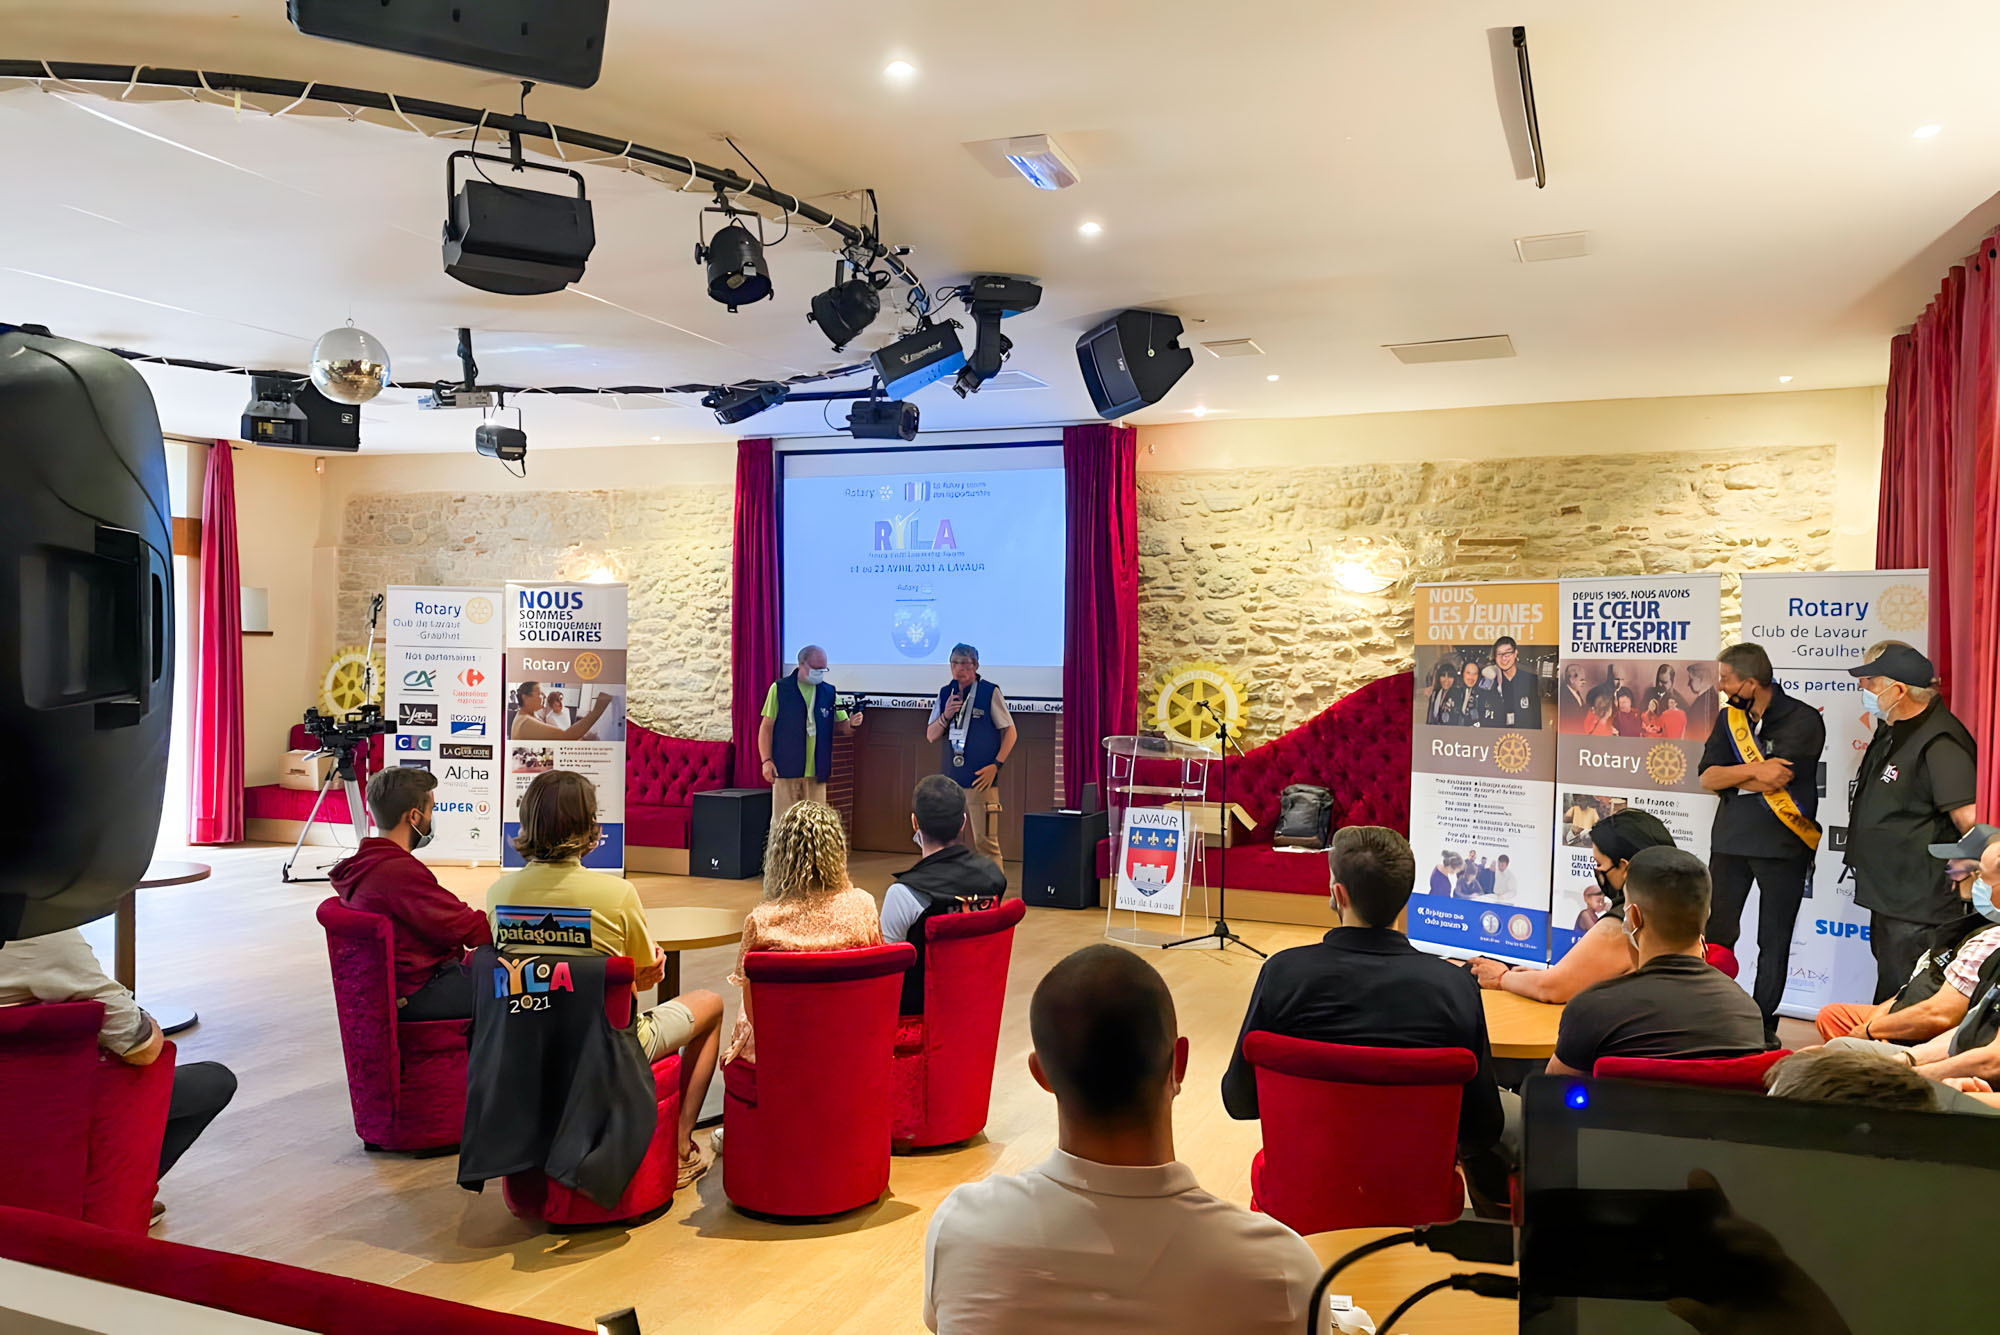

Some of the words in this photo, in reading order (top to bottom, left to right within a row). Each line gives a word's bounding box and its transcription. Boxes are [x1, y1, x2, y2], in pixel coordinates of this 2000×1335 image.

[874, 507, 957, 551] RYLA
[947, 563, 985, 572] LAVAUR
[519, 590, 583, 610] NOUS
[1429, 586, 1479, 605] NOUS,
[1572, 591, 1604, 600] DEPUIS
[1631, 589, 1656, 599] NOUS
[1658, 588, 1691, 598] AVONS
[415, 601, 462, 618] Rotary
[519, 609, 573, 620] SOMMES
[1428, 605, 1460, 624] LES
[1465, 602, 1544, 624] JEUNES
[1572, 602, 1594, 620] LE
[1599, 600, 1660, 620] CŒUR
[1788, 598, 1869, 621] Rotary
[519, 620, 602, 630] HISTORIQUEMENT
[1428, 624, 1454, 641] ON
[1457, 624, 1469, 641] Y
[1472, 623, 1526, 641] CROIT
[1572, 621, 1596, 640] ET
[1600, 620, 1691, 641] L'ESPRIT
[1751, 625, 1785, 638] Club
[1790, 624, 1809, 638] de
[1814, 625, 1869, 639] Lavaur
[519, 630, 602, 642] SOLIDAIRES
[1571, 641, 1678, 653] D'ENTREPRENDRE
[1791, 644, 1866, 658] -Graulhet
[522, 657, 570, 673] Rotary
[1779, 678, 1799, 690] os
[1804, 679, 1864, 693] partena
[1431, 739, 1490, 762] Rotary
[1579, 749, 1641, 773] Rotary
[445, 765, 489, 780] Aloha
[432, 802, 474, 813] SUPER
[1133, 814, 1178, 828] LAVAUR
[498, 927, 586, 945] patagonia
[1815, 918, 1871, 941] SUPE
[493, 955, 574, 998] RYLA
[509, 994, 552, 1014] 2021
